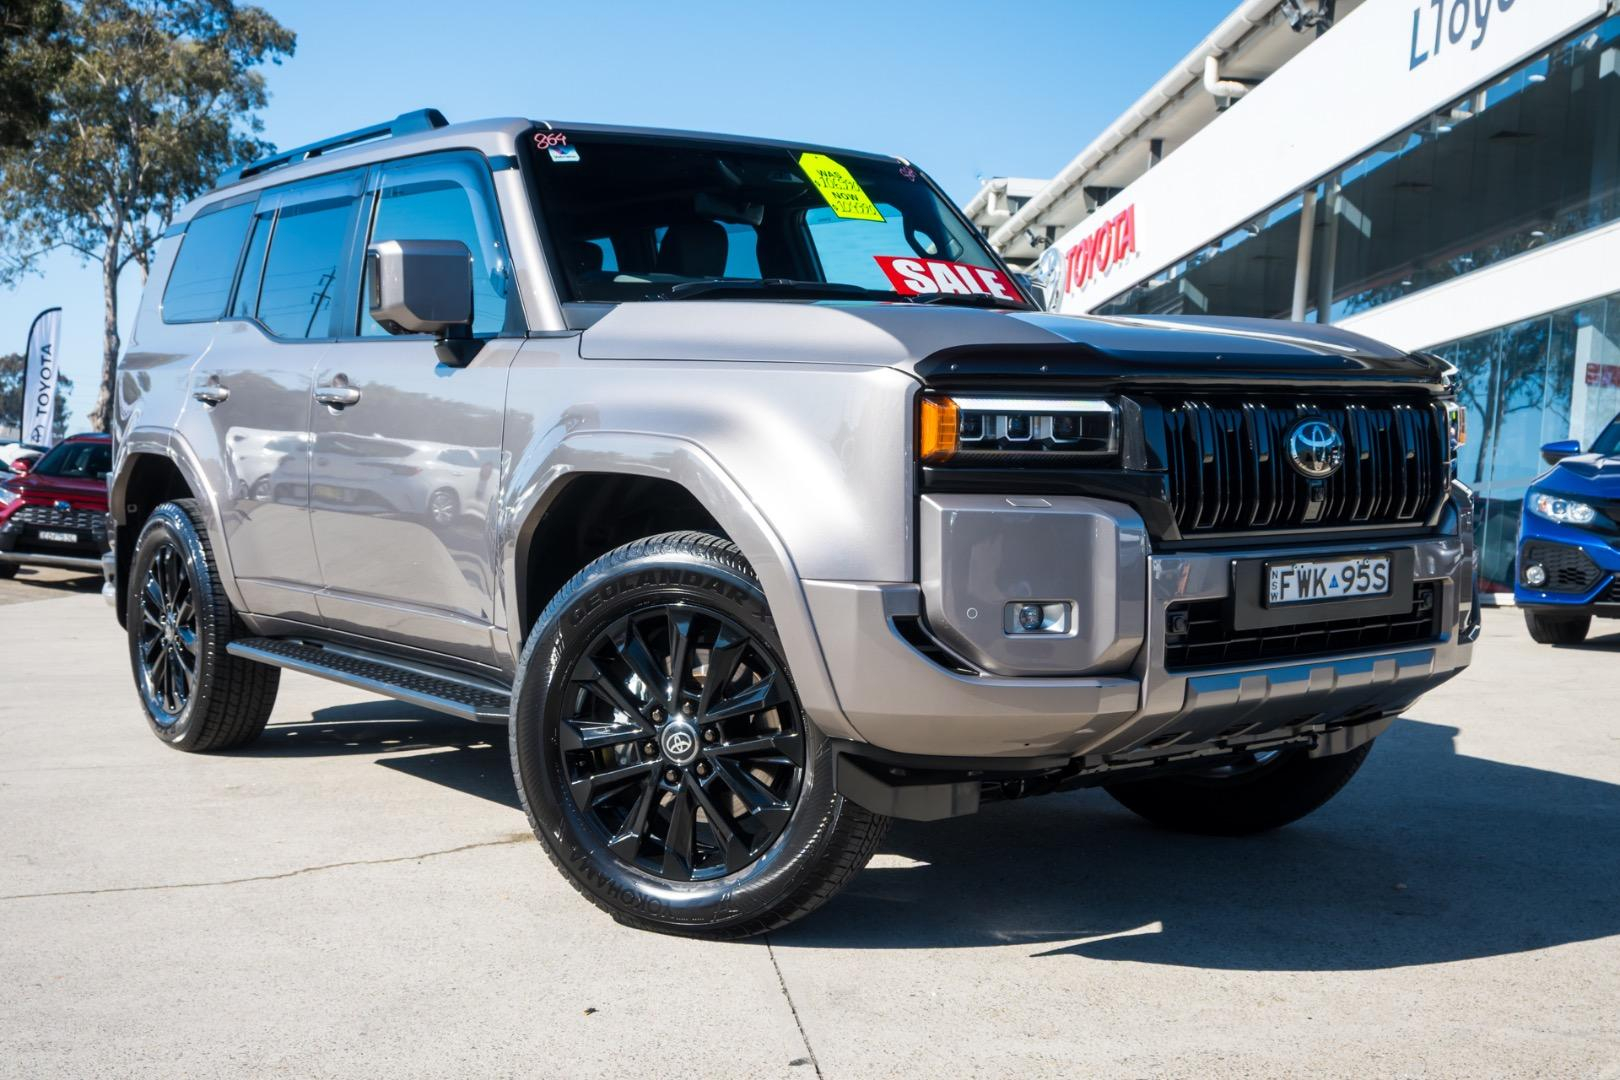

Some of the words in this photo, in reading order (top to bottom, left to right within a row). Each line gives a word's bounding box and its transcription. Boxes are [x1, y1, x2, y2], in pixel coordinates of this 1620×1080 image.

[816, 170, 842, 179] WAS
[832, 192, 859, 201] NOW
[1065, 204, 1135, 293] TOYOTA
[892, 259, 1014, 301] SALE
[36, 343, 53, 417] TOYOTA
[1271, 570, 1279, 602] NSW
[1280, 567, 1327, 600] FWK
[1341, 563, 1386, 593] 95S
[569, 849, 673, 918] YOKOHAMA
